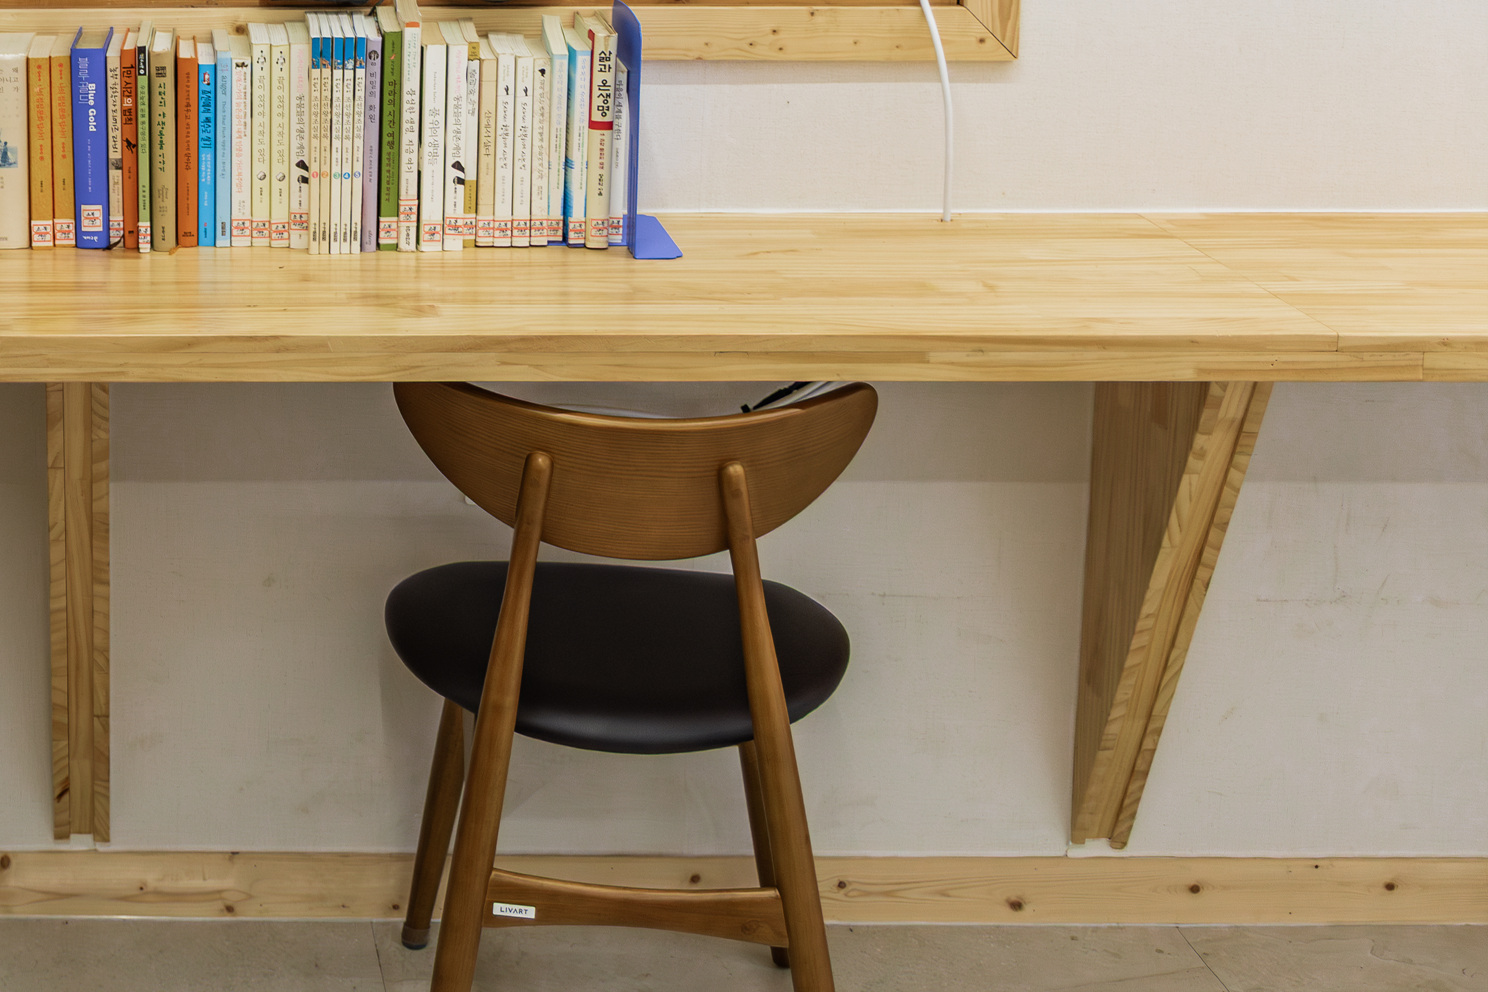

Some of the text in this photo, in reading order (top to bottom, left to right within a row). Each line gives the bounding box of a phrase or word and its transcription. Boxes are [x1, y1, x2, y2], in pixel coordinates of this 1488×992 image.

[36, 84, 44, 96] 나의
[58, 82, 65, 94] 나의
[78, 57, 90, 104] 블루골드
[597, 50, 612, 117] 삶과 온생명
[88, 84, 96, 106] Blue
[122, 64, 134, 126] 1만 시간의 법칙
[157, 82, 166, 108] 시턴의
[201, 90, 212, 114] 조선에서
[406, 88, 416, 114] 풍성한
[184, 102, 192, 120] 배우고
[258, 76, 266, 164] 끝이 있어야 시작도 있다
[277, 76, 285, 165] 끝이 있어야 시작도 있다
[296, 94, 305, 126] 동물들의
[322, 95, 330, 140] 조선왕조실록
[344, 96, 352, 140] 조선왕조실록
[368, 104, 376, 124] 화원
[453, 94, 462, 126] 동물들의
[201, 116, 212, 134] 백수로
[386, 110, 396, 150] 시간 여행
[428, 108, 440, 165] 풀 위의 생명들
[484, 110, 492, 158] 산에서 살다
[614, 122, 622, 140] 구한다
[140, 144, 147, 154] 있다
[201, 136, 212, 149] 살기
[404, 140, 414, 155] 지금
[404, 158, 414, 174] 여기
[500, 906, 528, 914] LIVART
